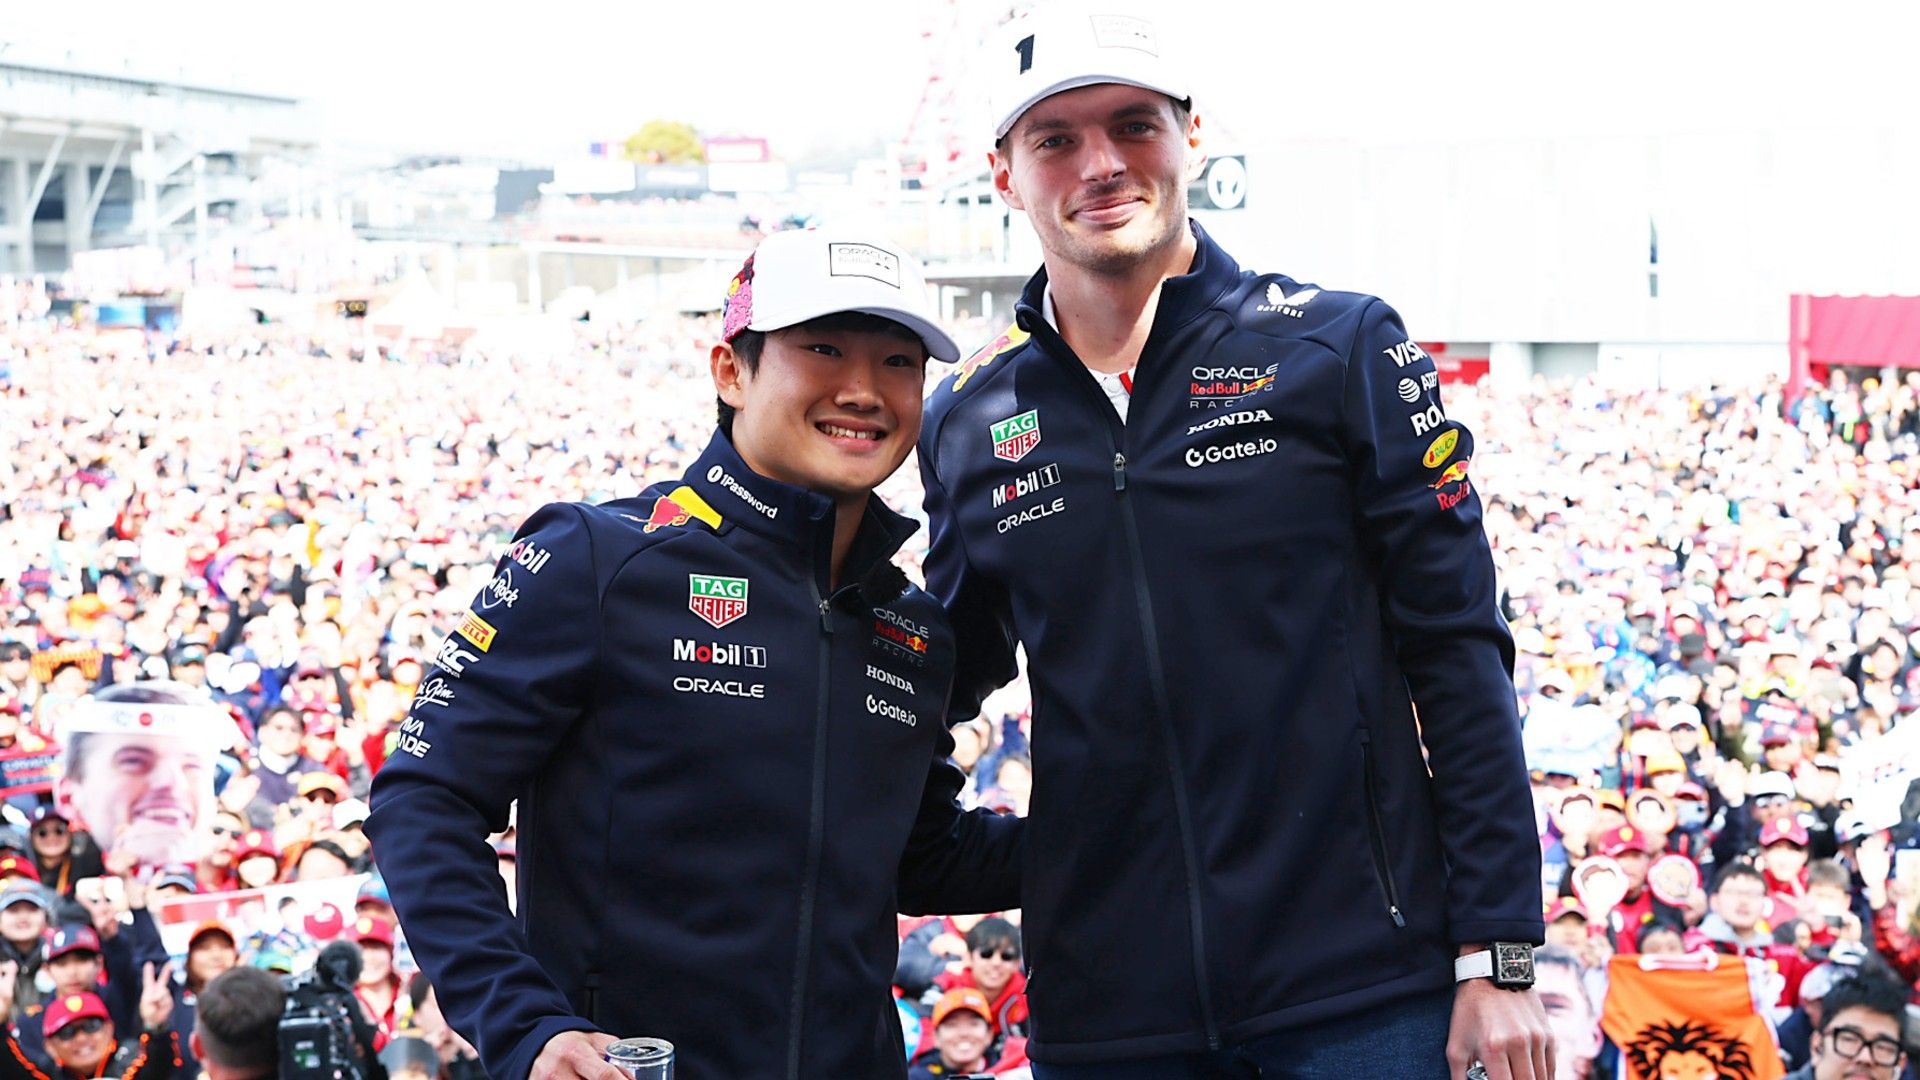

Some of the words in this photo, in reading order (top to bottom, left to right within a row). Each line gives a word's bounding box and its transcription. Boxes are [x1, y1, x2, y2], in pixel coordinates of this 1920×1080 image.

[1015, 34, 1035, 75] 1
[1191, 363, 1279, 380] ORACLE
[1190, 382, 1214, 395] Red
[1216, 381, 1240, 395] Bull
[995, 414, 1034, 440] TAG
[1186, 409, 1274, 435] HONDA
[997, 431, 1037, 459] HEUER
[1205, 438, 1278, 463] Gate.io
[719, 473, 779, 519] 1Password
[992, 470, 1040, 509] Mobil
[997, 497, 1065, 534] ORACLE
[695, 578, 742, 597] TAG
[692, 598, 743, 624] HEUER
[873, 607, 930, 640] ORACLE
[673, 639, 740, 666] Mobil
[673, 677, 765, 699] ORACLE
[865, 664, 916, 695] HONDA
[878, 700, 917, 728] Gate.io
